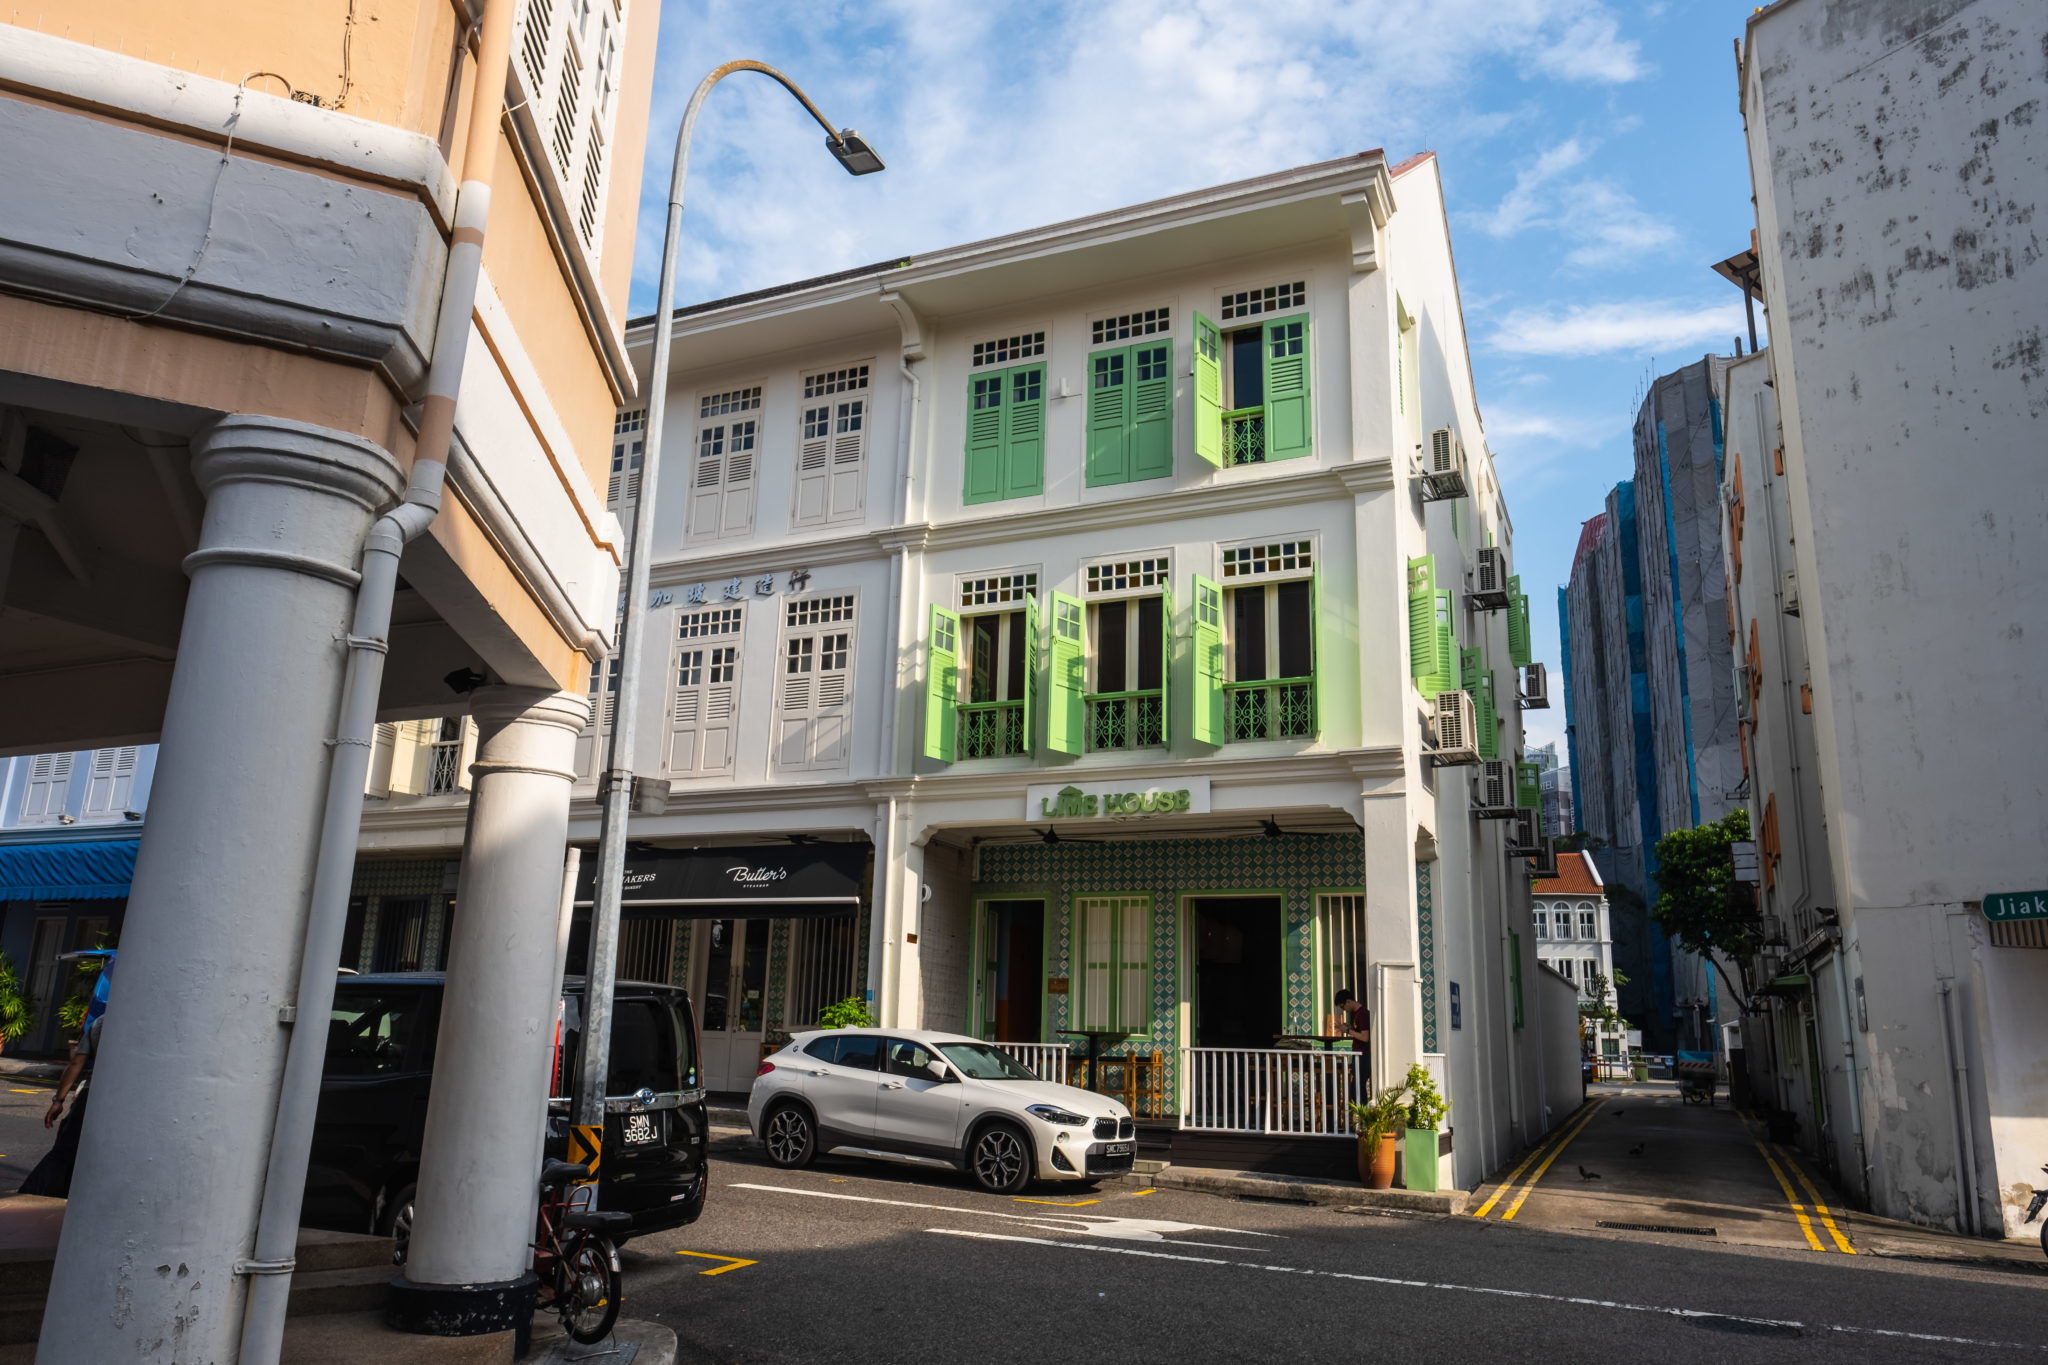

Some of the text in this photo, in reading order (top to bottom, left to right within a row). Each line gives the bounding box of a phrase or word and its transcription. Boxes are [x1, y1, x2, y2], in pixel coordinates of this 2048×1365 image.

[617, 569, 811, 611] 加坡建造行
[1040, 789, 1190, 817] LIME HOUSE
[726, 866, 788, 882] Butler's
[1996, 895, 2048, 917] Jiak
[629, 1114, 650, 1129] SMN
[624, 1126, 658, 1143] 3682J
